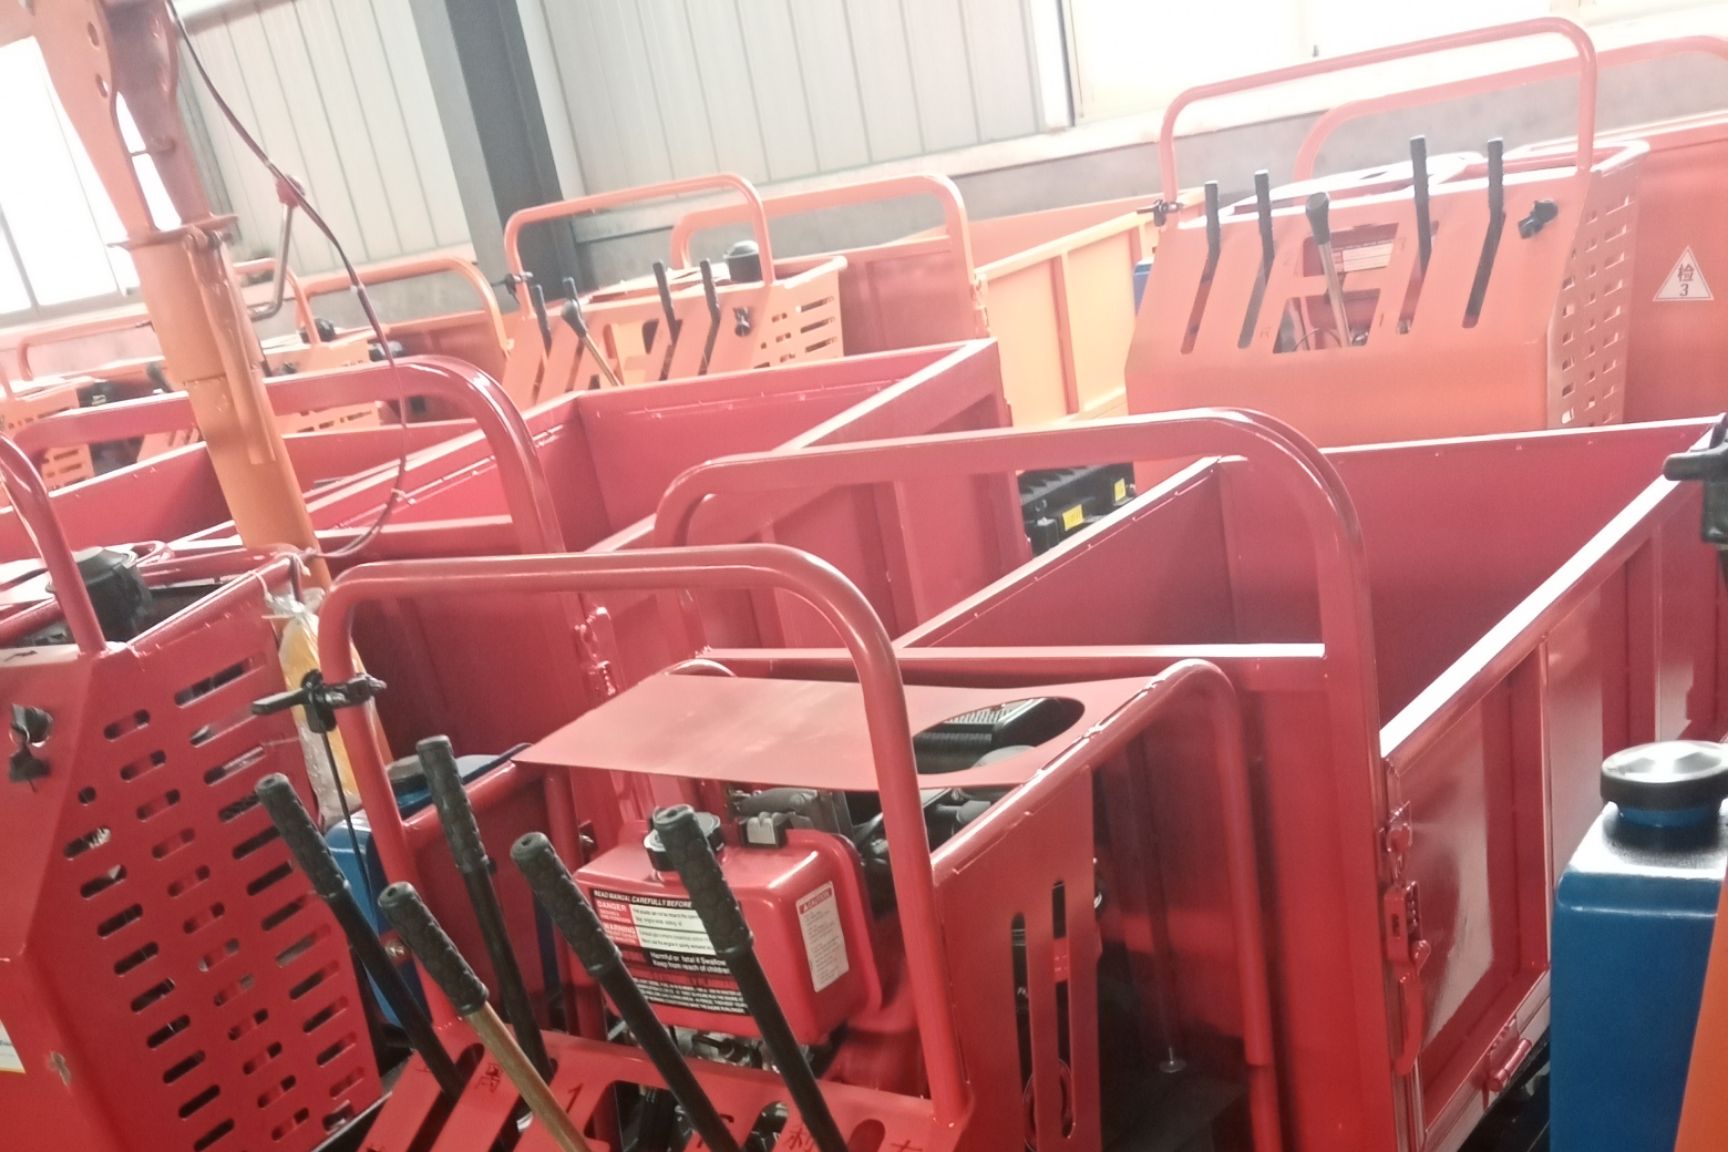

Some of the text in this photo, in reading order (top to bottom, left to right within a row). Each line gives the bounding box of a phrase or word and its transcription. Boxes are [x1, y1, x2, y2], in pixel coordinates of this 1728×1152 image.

[1679, 283, 1690, 297] 3
[631, 896, 667, 907] CAREFULLY
[666, 900, 692, 909] BEFORE
[565, 1083, 584, 1114] 1
